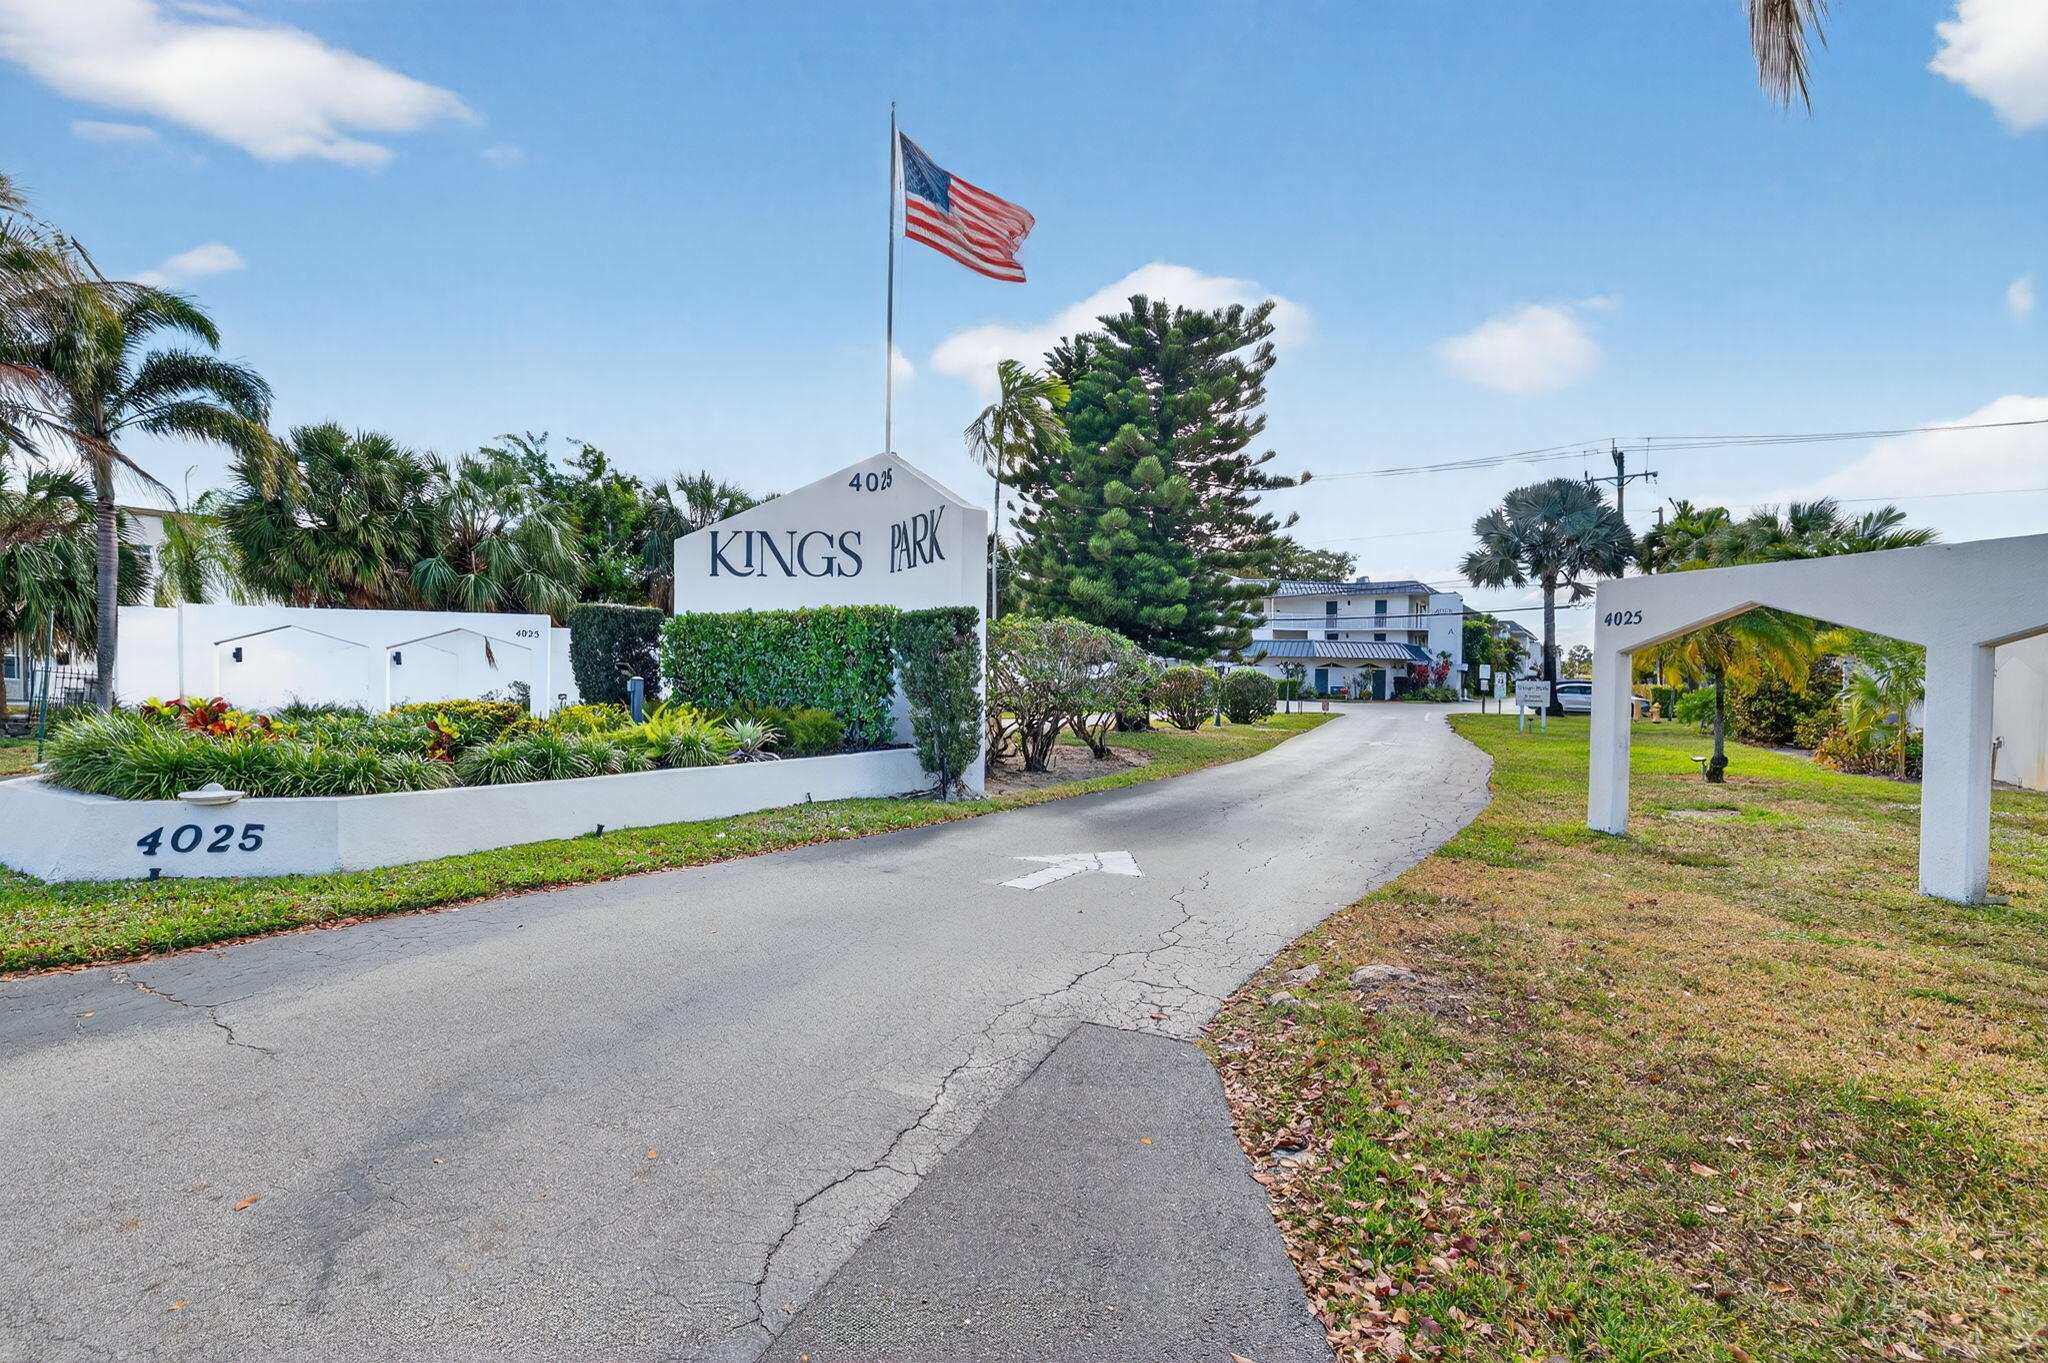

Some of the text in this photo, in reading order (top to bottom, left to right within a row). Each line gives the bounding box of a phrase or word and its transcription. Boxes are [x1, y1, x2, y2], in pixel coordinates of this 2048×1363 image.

[848, 467, 892, 492] 4025
[709, 504, 946, 578] KINGS PARK
[1604, 610, 1643, 627] 4025
[515, 629, 540, 638] 4025
[136, 823, 265, 856] 4025
